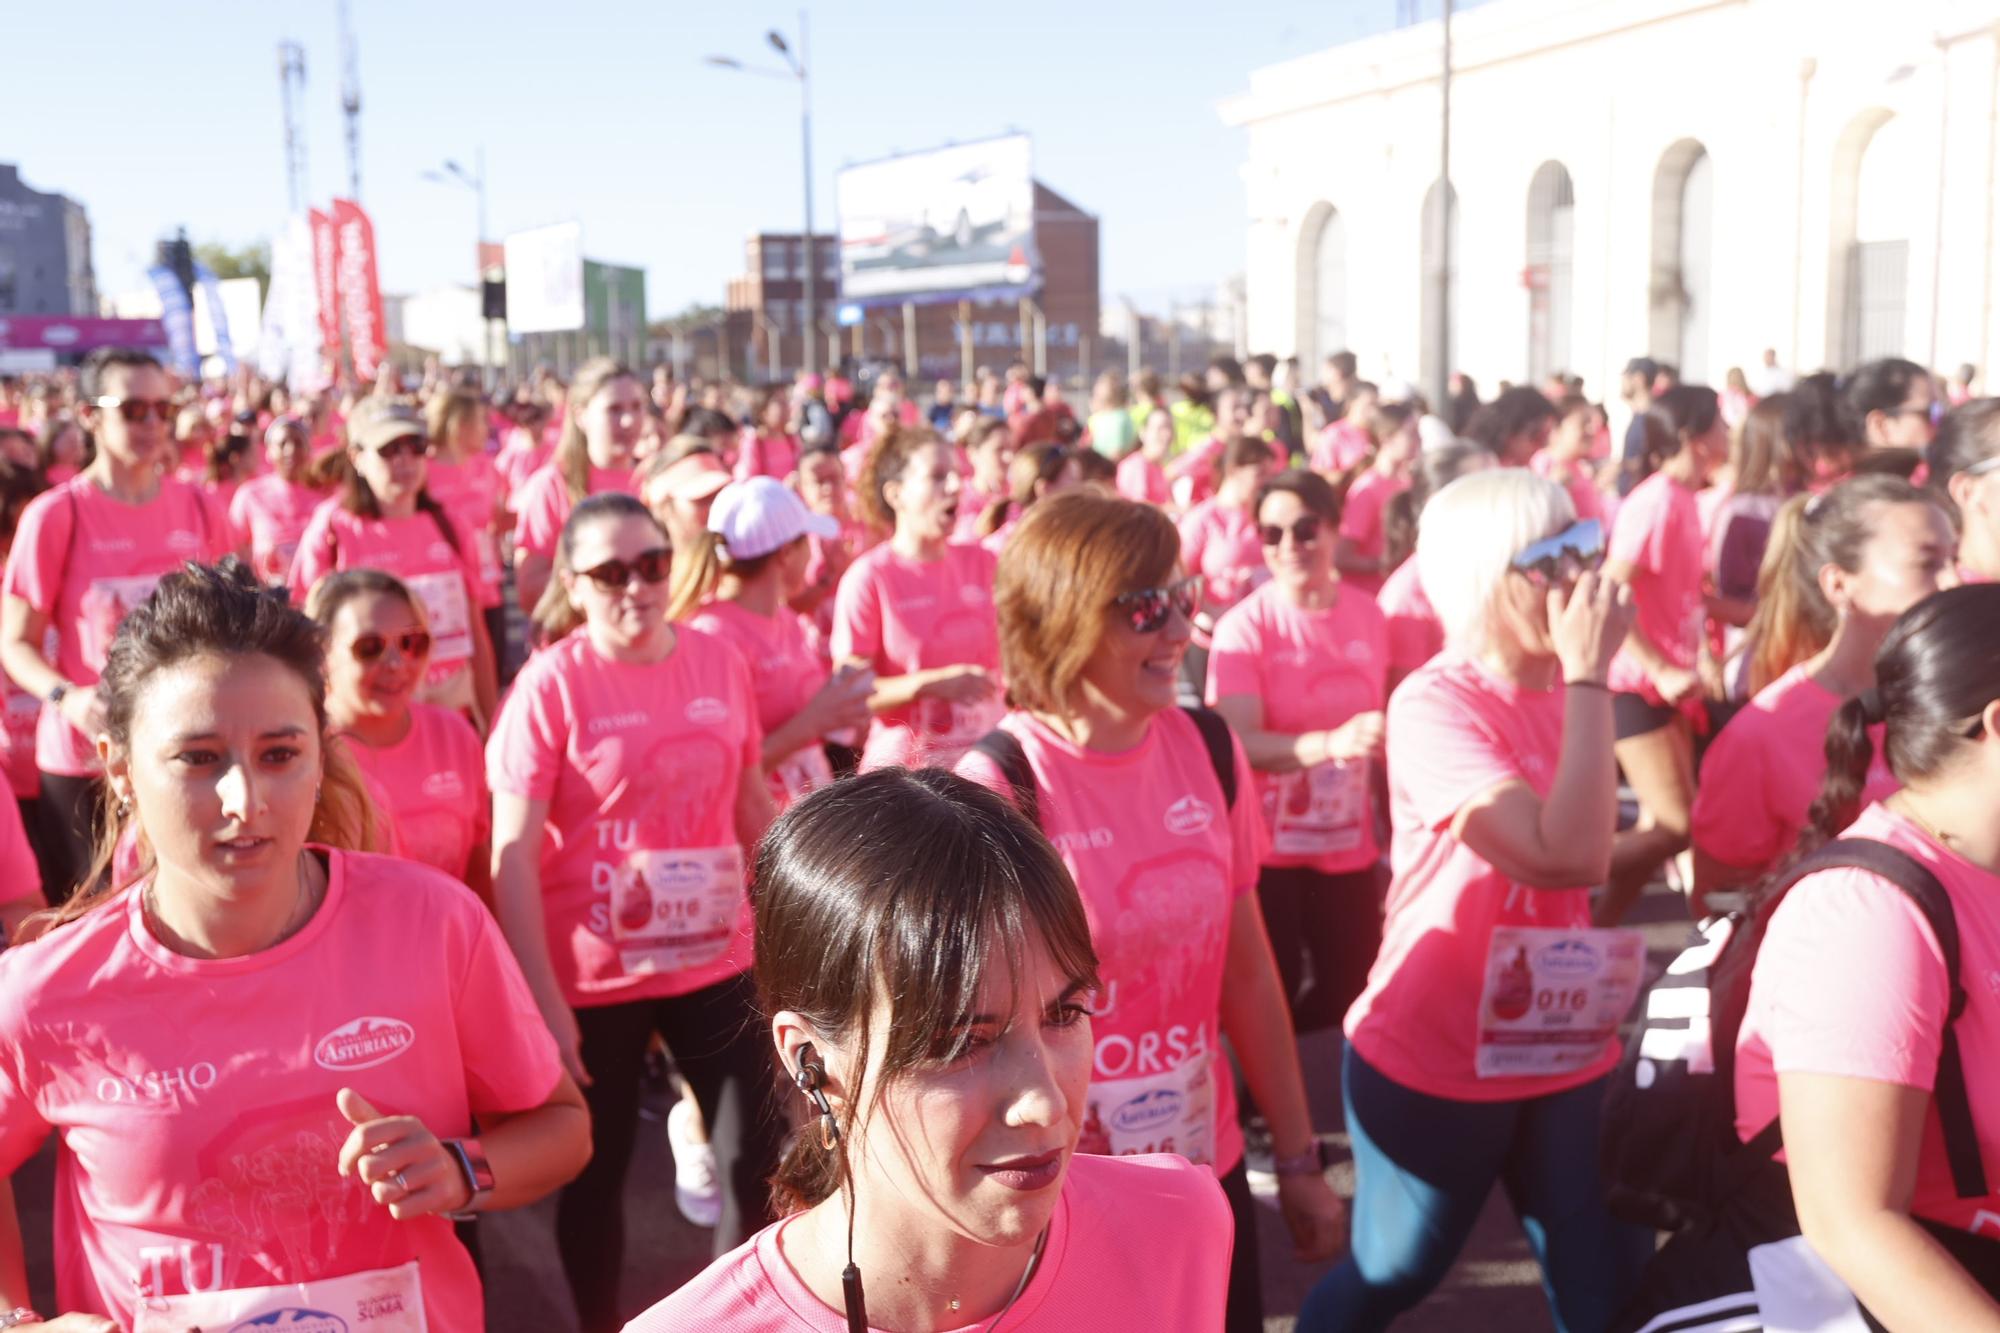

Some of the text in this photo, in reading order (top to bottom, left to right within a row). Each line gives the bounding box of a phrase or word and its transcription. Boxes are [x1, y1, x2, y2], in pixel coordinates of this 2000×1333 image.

[594, 819, 637, 849] TU
[1536, 988, 1588, 1011] 016
[324, 1032, 407, 1063] ASTURIANA
[97, 1061, 217, 1103] OYSHO
[139, 1243, 223, 1294] TU
